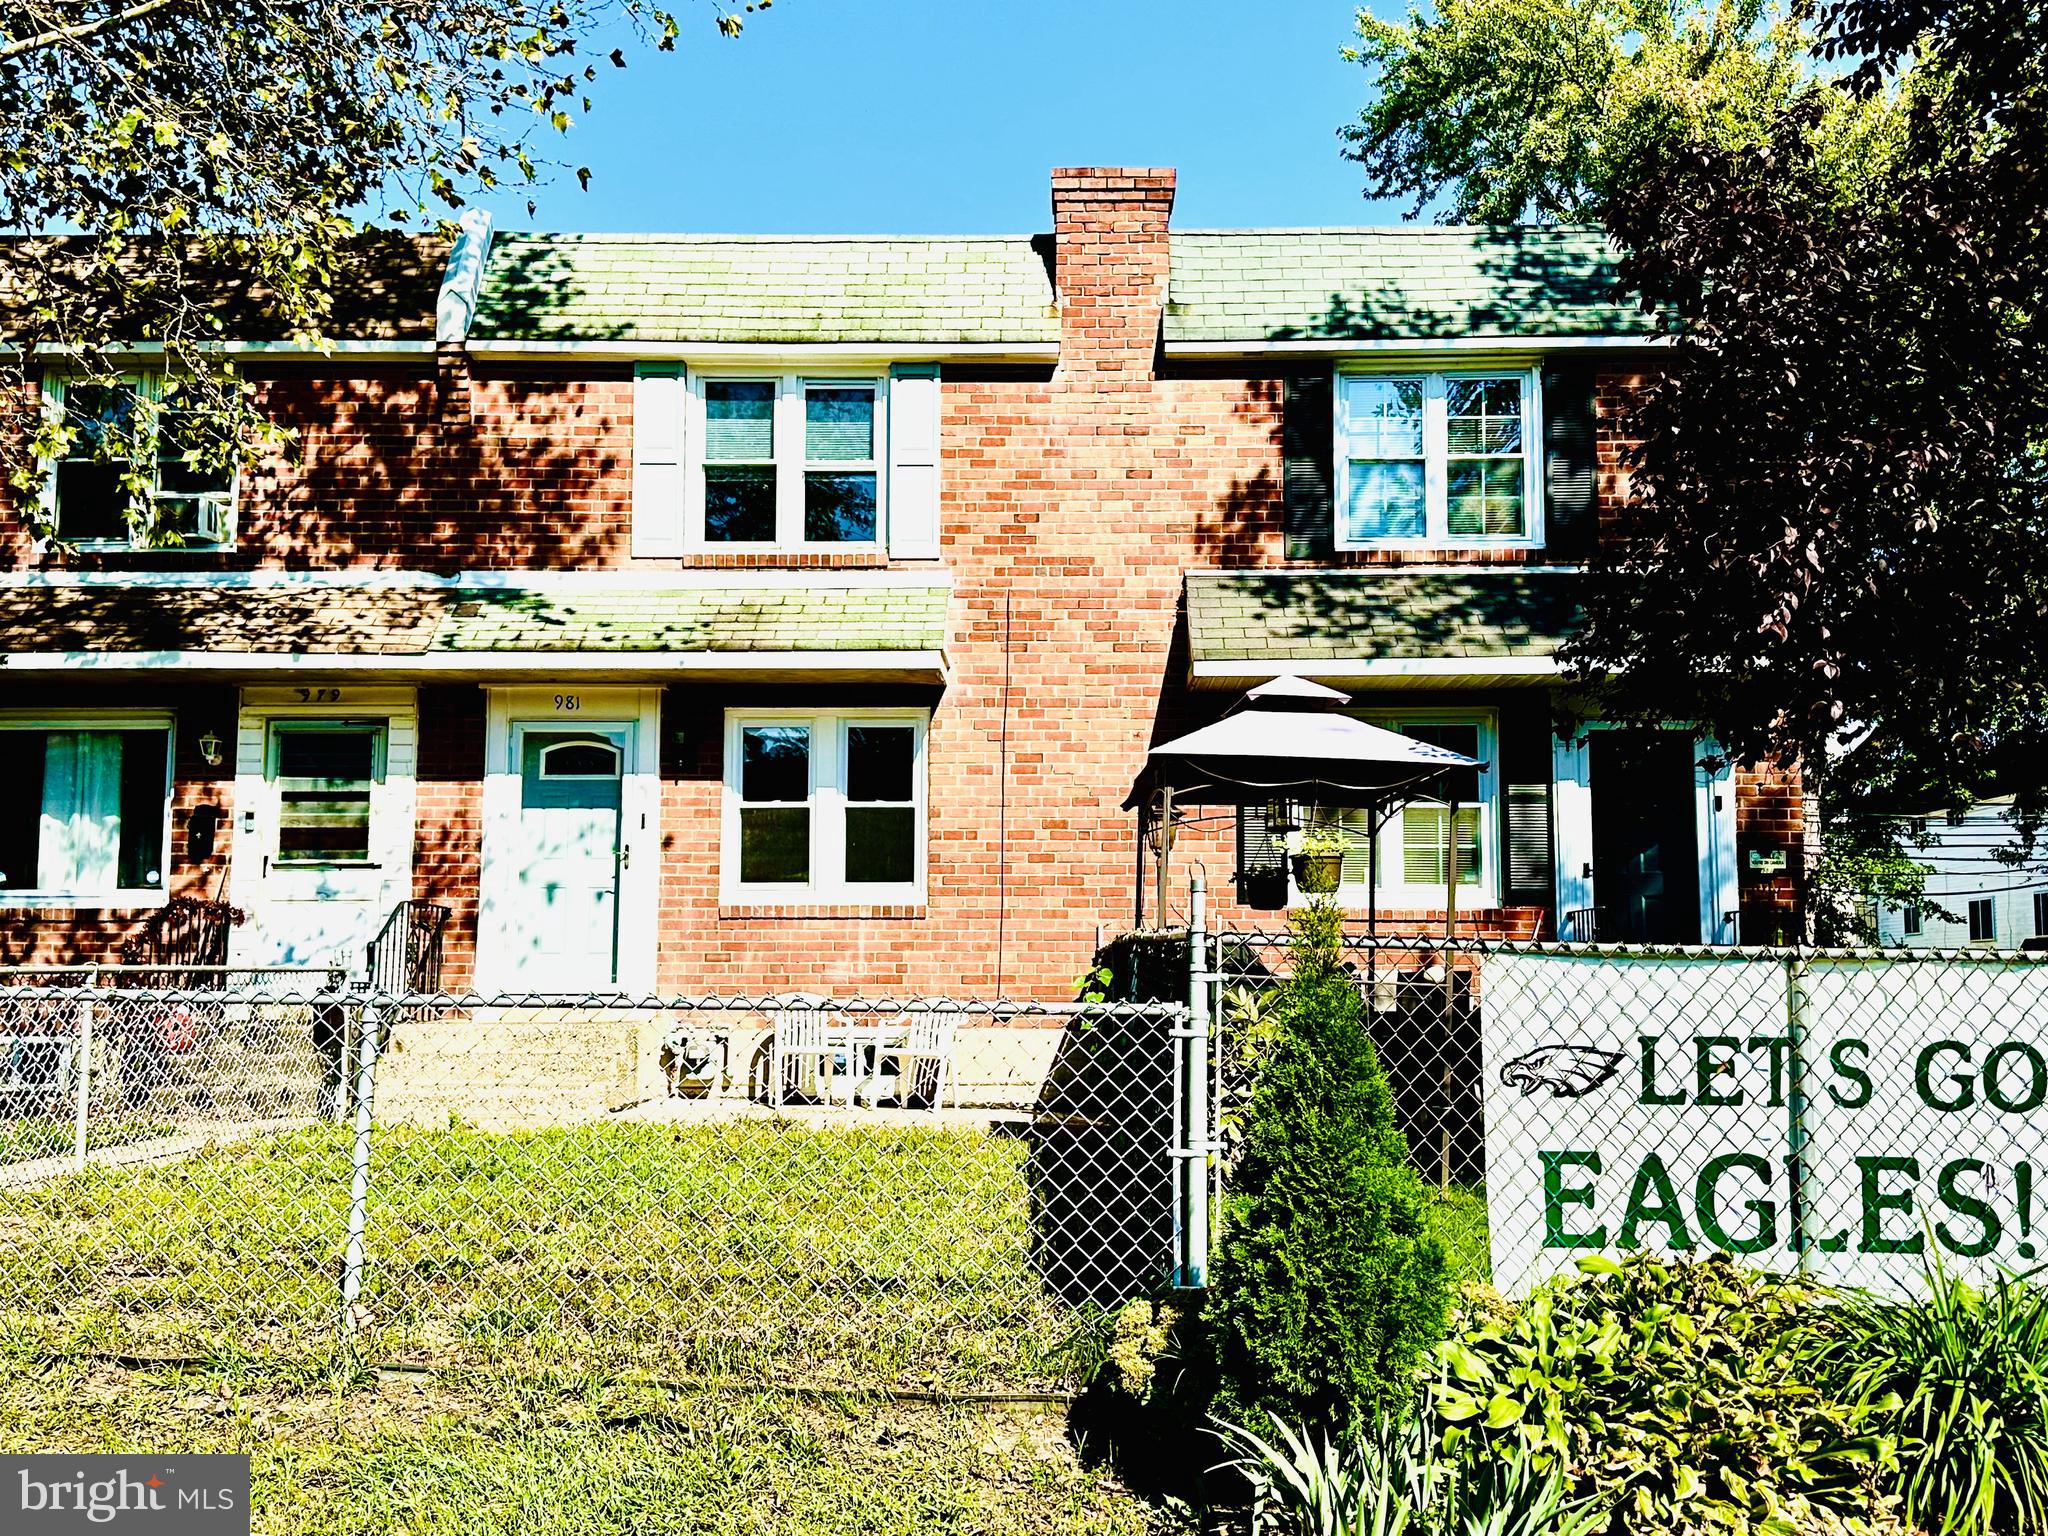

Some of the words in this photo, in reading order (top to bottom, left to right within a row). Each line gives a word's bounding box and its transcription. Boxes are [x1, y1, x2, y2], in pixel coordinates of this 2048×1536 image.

[554, 694, 580, 710] 981
[1638, 1036, 1874, 1109] LETS
[1915, 1040, 2048, 1114] GO
[1537, 1150, 2036, 1259] EAGLES!
